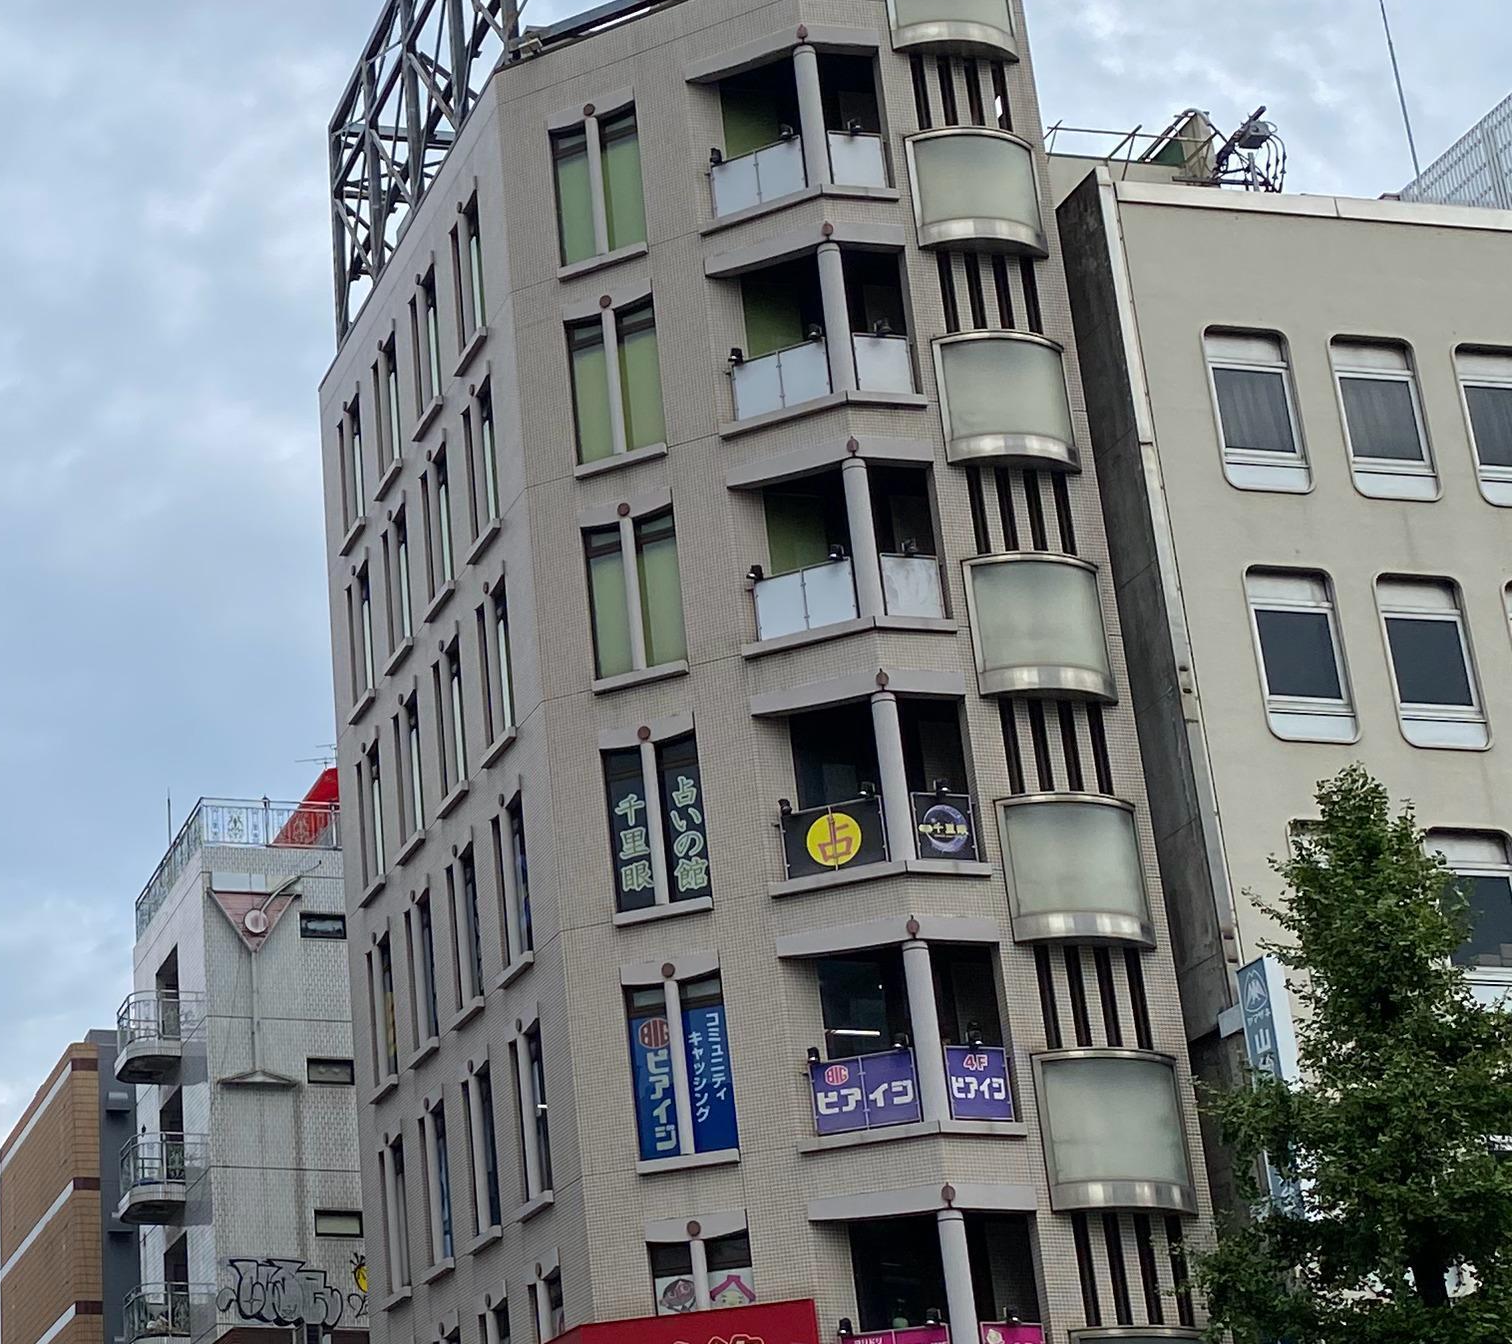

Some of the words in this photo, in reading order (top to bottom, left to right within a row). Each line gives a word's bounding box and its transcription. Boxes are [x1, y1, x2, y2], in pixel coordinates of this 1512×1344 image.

[614, 793, 657, 892] 千里眼
[670, 775, 709, 892] 占いの館
[688, 1031, 711, 1123] キャッシング
[705, 1012, 727, 1101] コミュニティ
[963, 1054, 988, 1071] 4F
